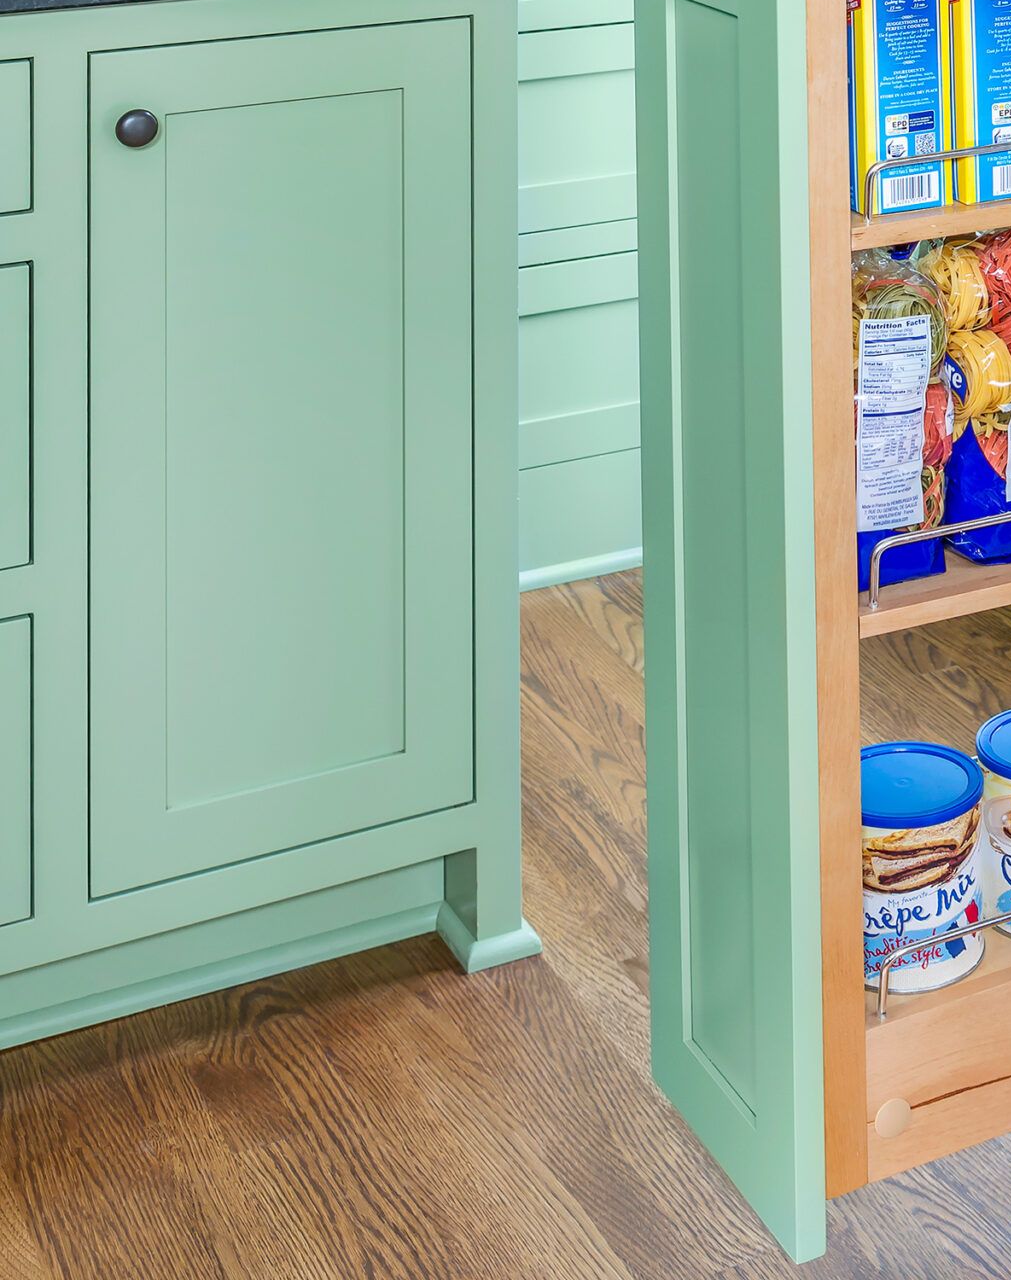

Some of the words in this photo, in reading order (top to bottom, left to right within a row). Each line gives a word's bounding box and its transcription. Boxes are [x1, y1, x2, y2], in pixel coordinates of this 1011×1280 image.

[892, 120, 907, 129] EPD
[906, 319, 926, 327] Facts
[864, 905, 931, 937] rêpe
[936, 866, 976, 916] Mix
[887, 899, 899, 908] My
[901, 891, 928, 905] favorite
[911, 944, 944, 970] style
